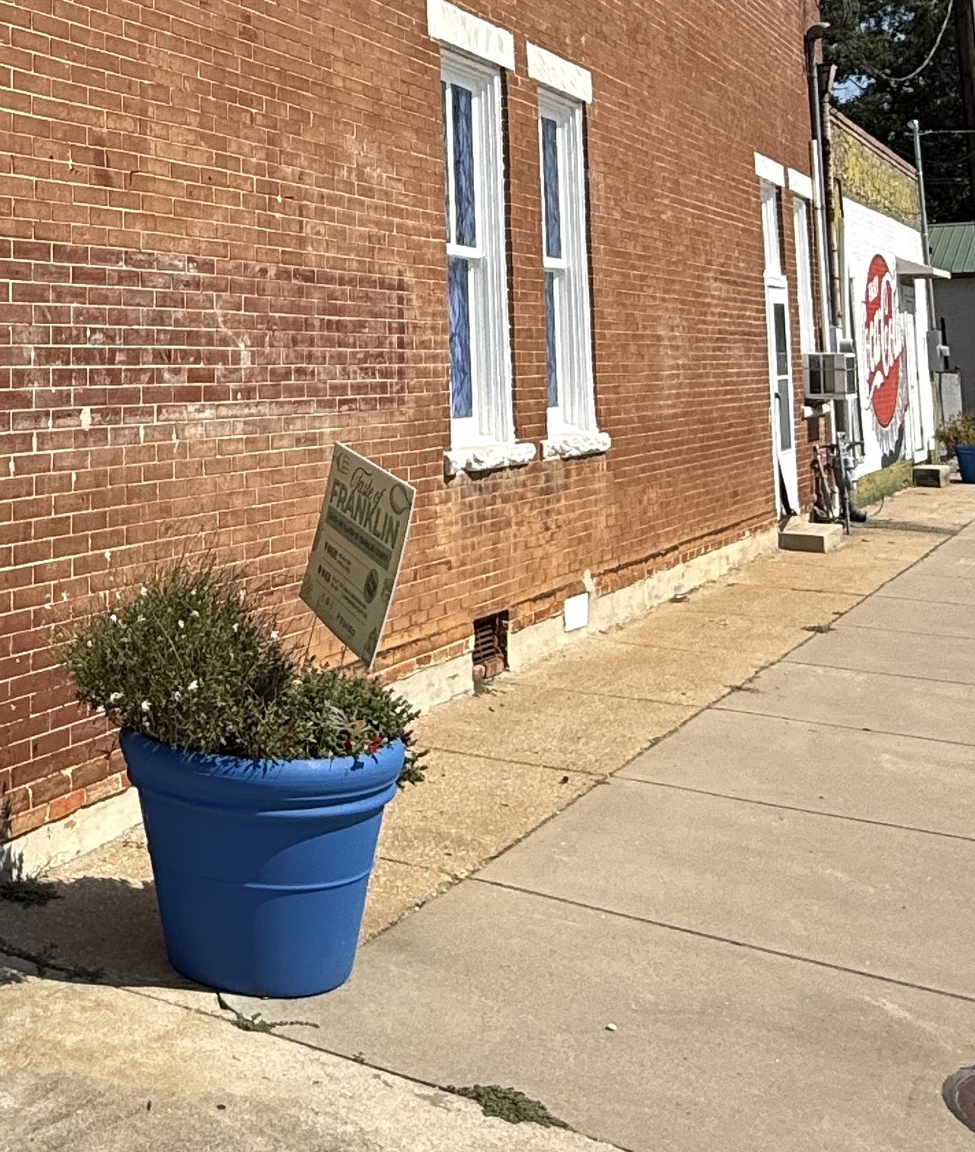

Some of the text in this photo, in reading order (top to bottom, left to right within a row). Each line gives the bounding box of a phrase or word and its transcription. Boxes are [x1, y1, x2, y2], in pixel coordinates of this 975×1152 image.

[329, 477, 401, 549] FRANKLIN
[349, 466, 387, 509] Taste of
